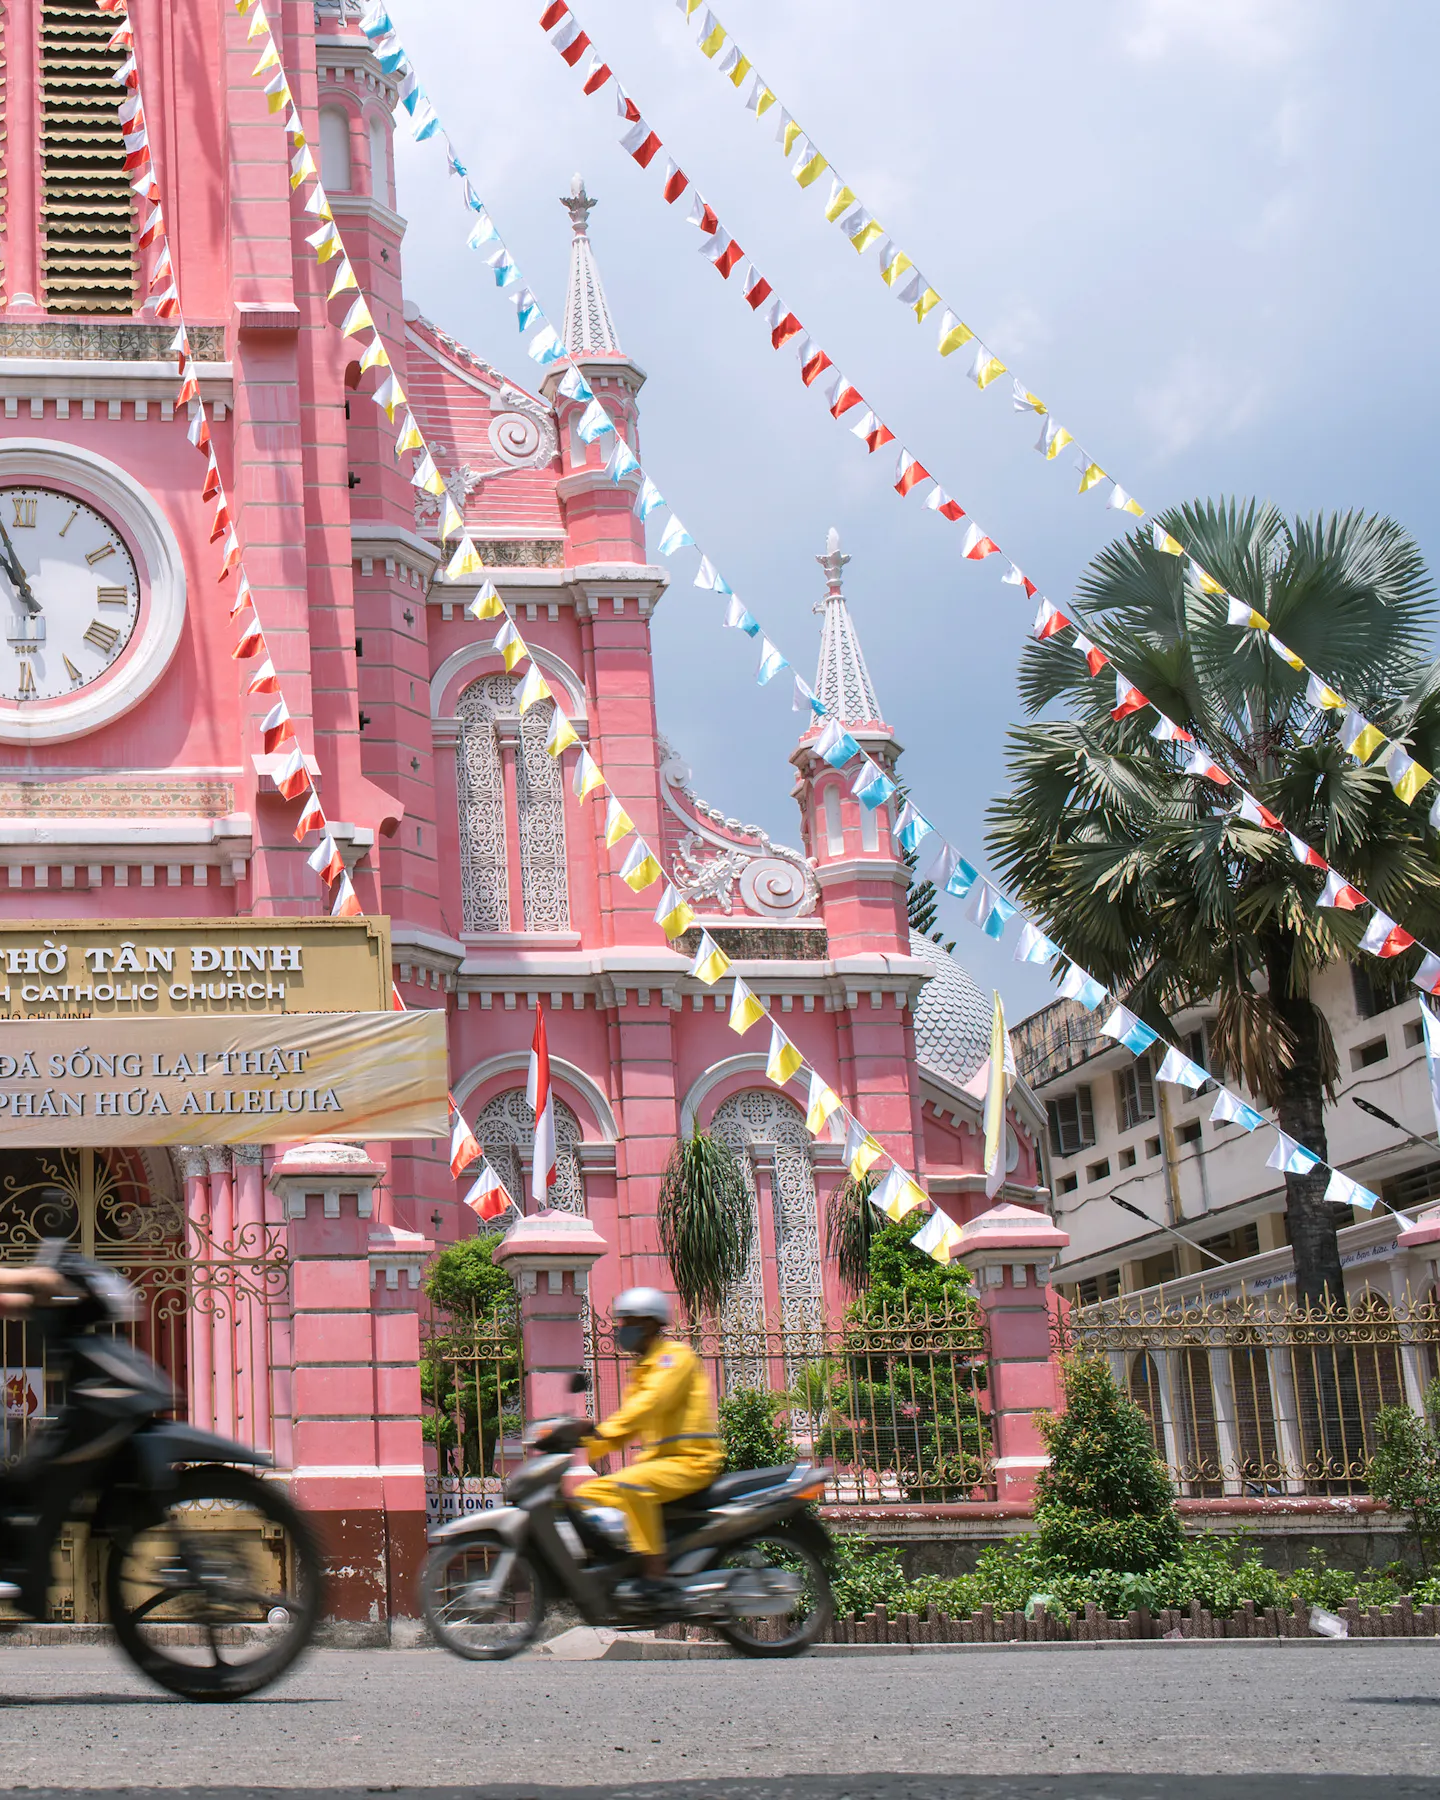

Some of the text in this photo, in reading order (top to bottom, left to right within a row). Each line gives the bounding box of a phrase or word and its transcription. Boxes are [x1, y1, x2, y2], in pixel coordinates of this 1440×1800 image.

[13, 498, 37, 527] XII
[59, 510, 78, 536] I
[85, 541, 116, 565] II
[97, 585, 127, 605] III
[83, 618, 121, 654] IIII
[18, 661, 37, 691] VI
[62, 653, 82, 680] V
[85, 941, 176, 973] TÂN
[190, 945, 303, 978] ĐỊNH
[21, 983, 159, 1003] CATHOLIC
[168, 983, 285, 1001] CHURCH
[48, 1045, 143, 1078] SỐNG
[151, 1053, 208, 1082] LẠI
[216, 1045, 309, 1080] THẬT
[93, 1087, 171, 1116] HỨA
[179, 1087, 344, 1114] ALLELUIA
